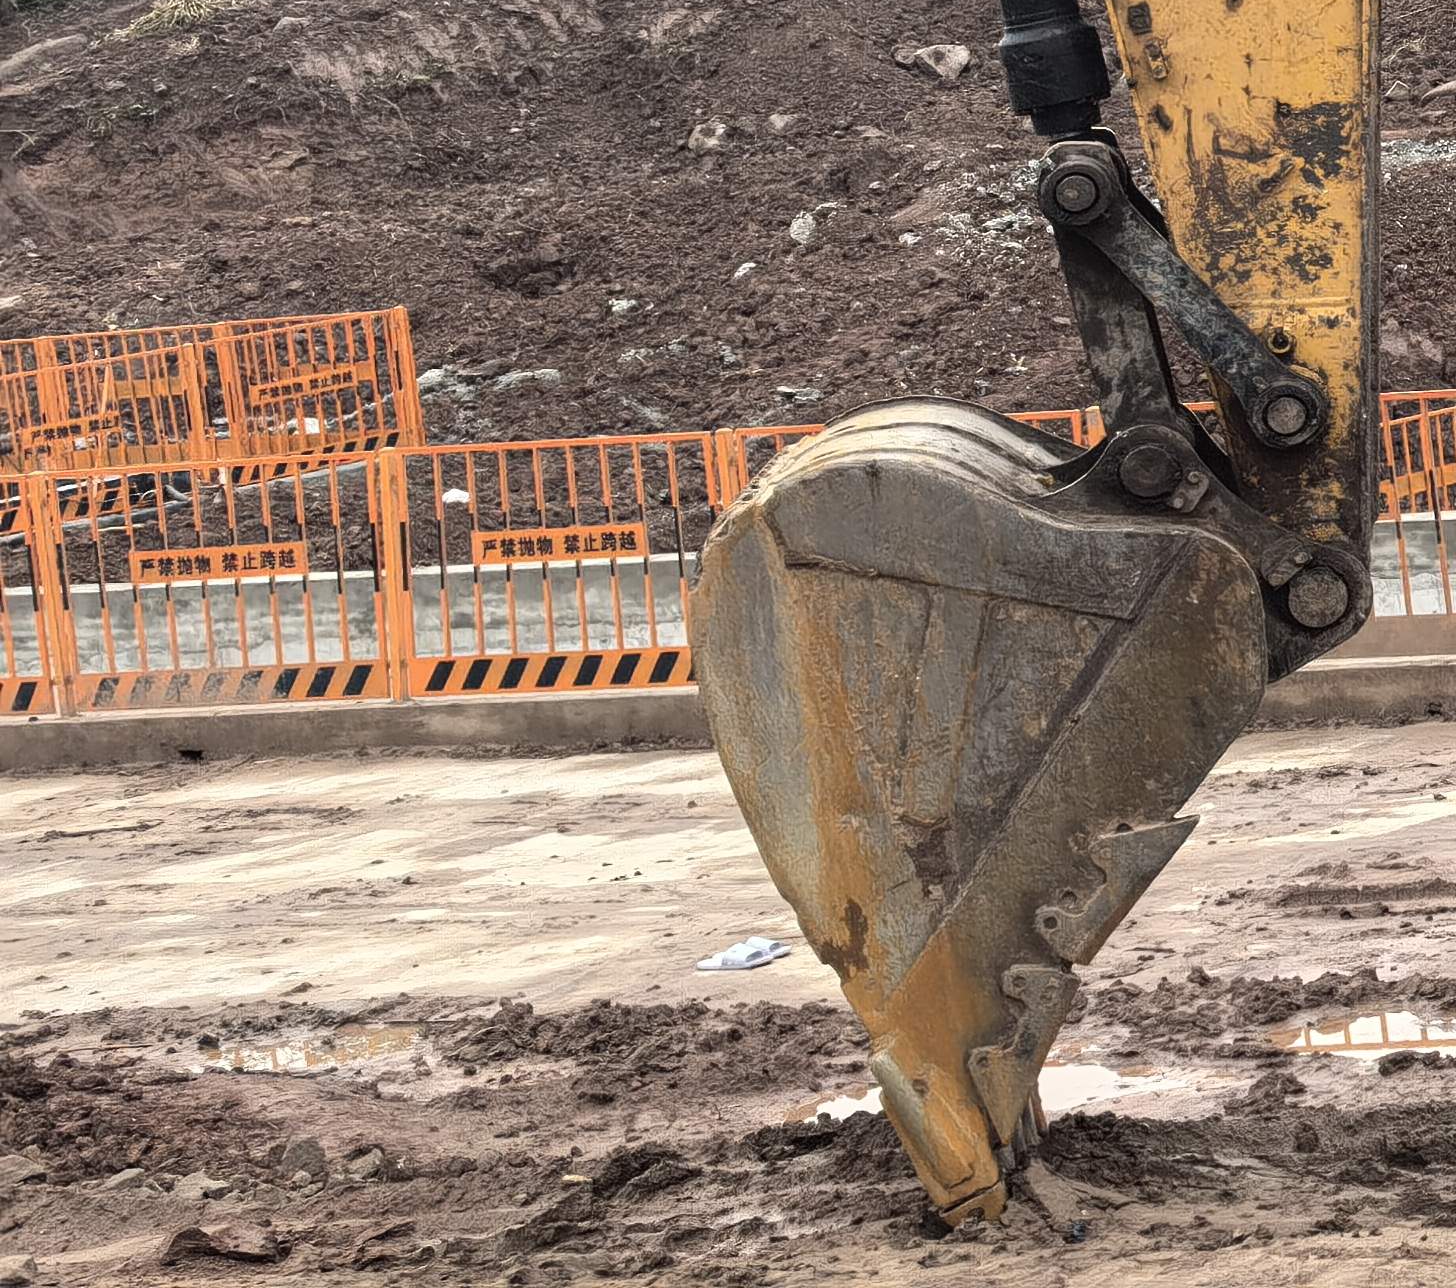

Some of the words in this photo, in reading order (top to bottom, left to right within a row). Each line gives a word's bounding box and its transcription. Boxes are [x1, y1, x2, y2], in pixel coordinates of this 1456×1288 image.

[482, 535, 553, 559] 严禁抛物
[564, 530, 637, 554] 禁止跨越
[140, 554, 211, 577] 严禁抛物
[222, 548, 296, 572] 禁止跨越
